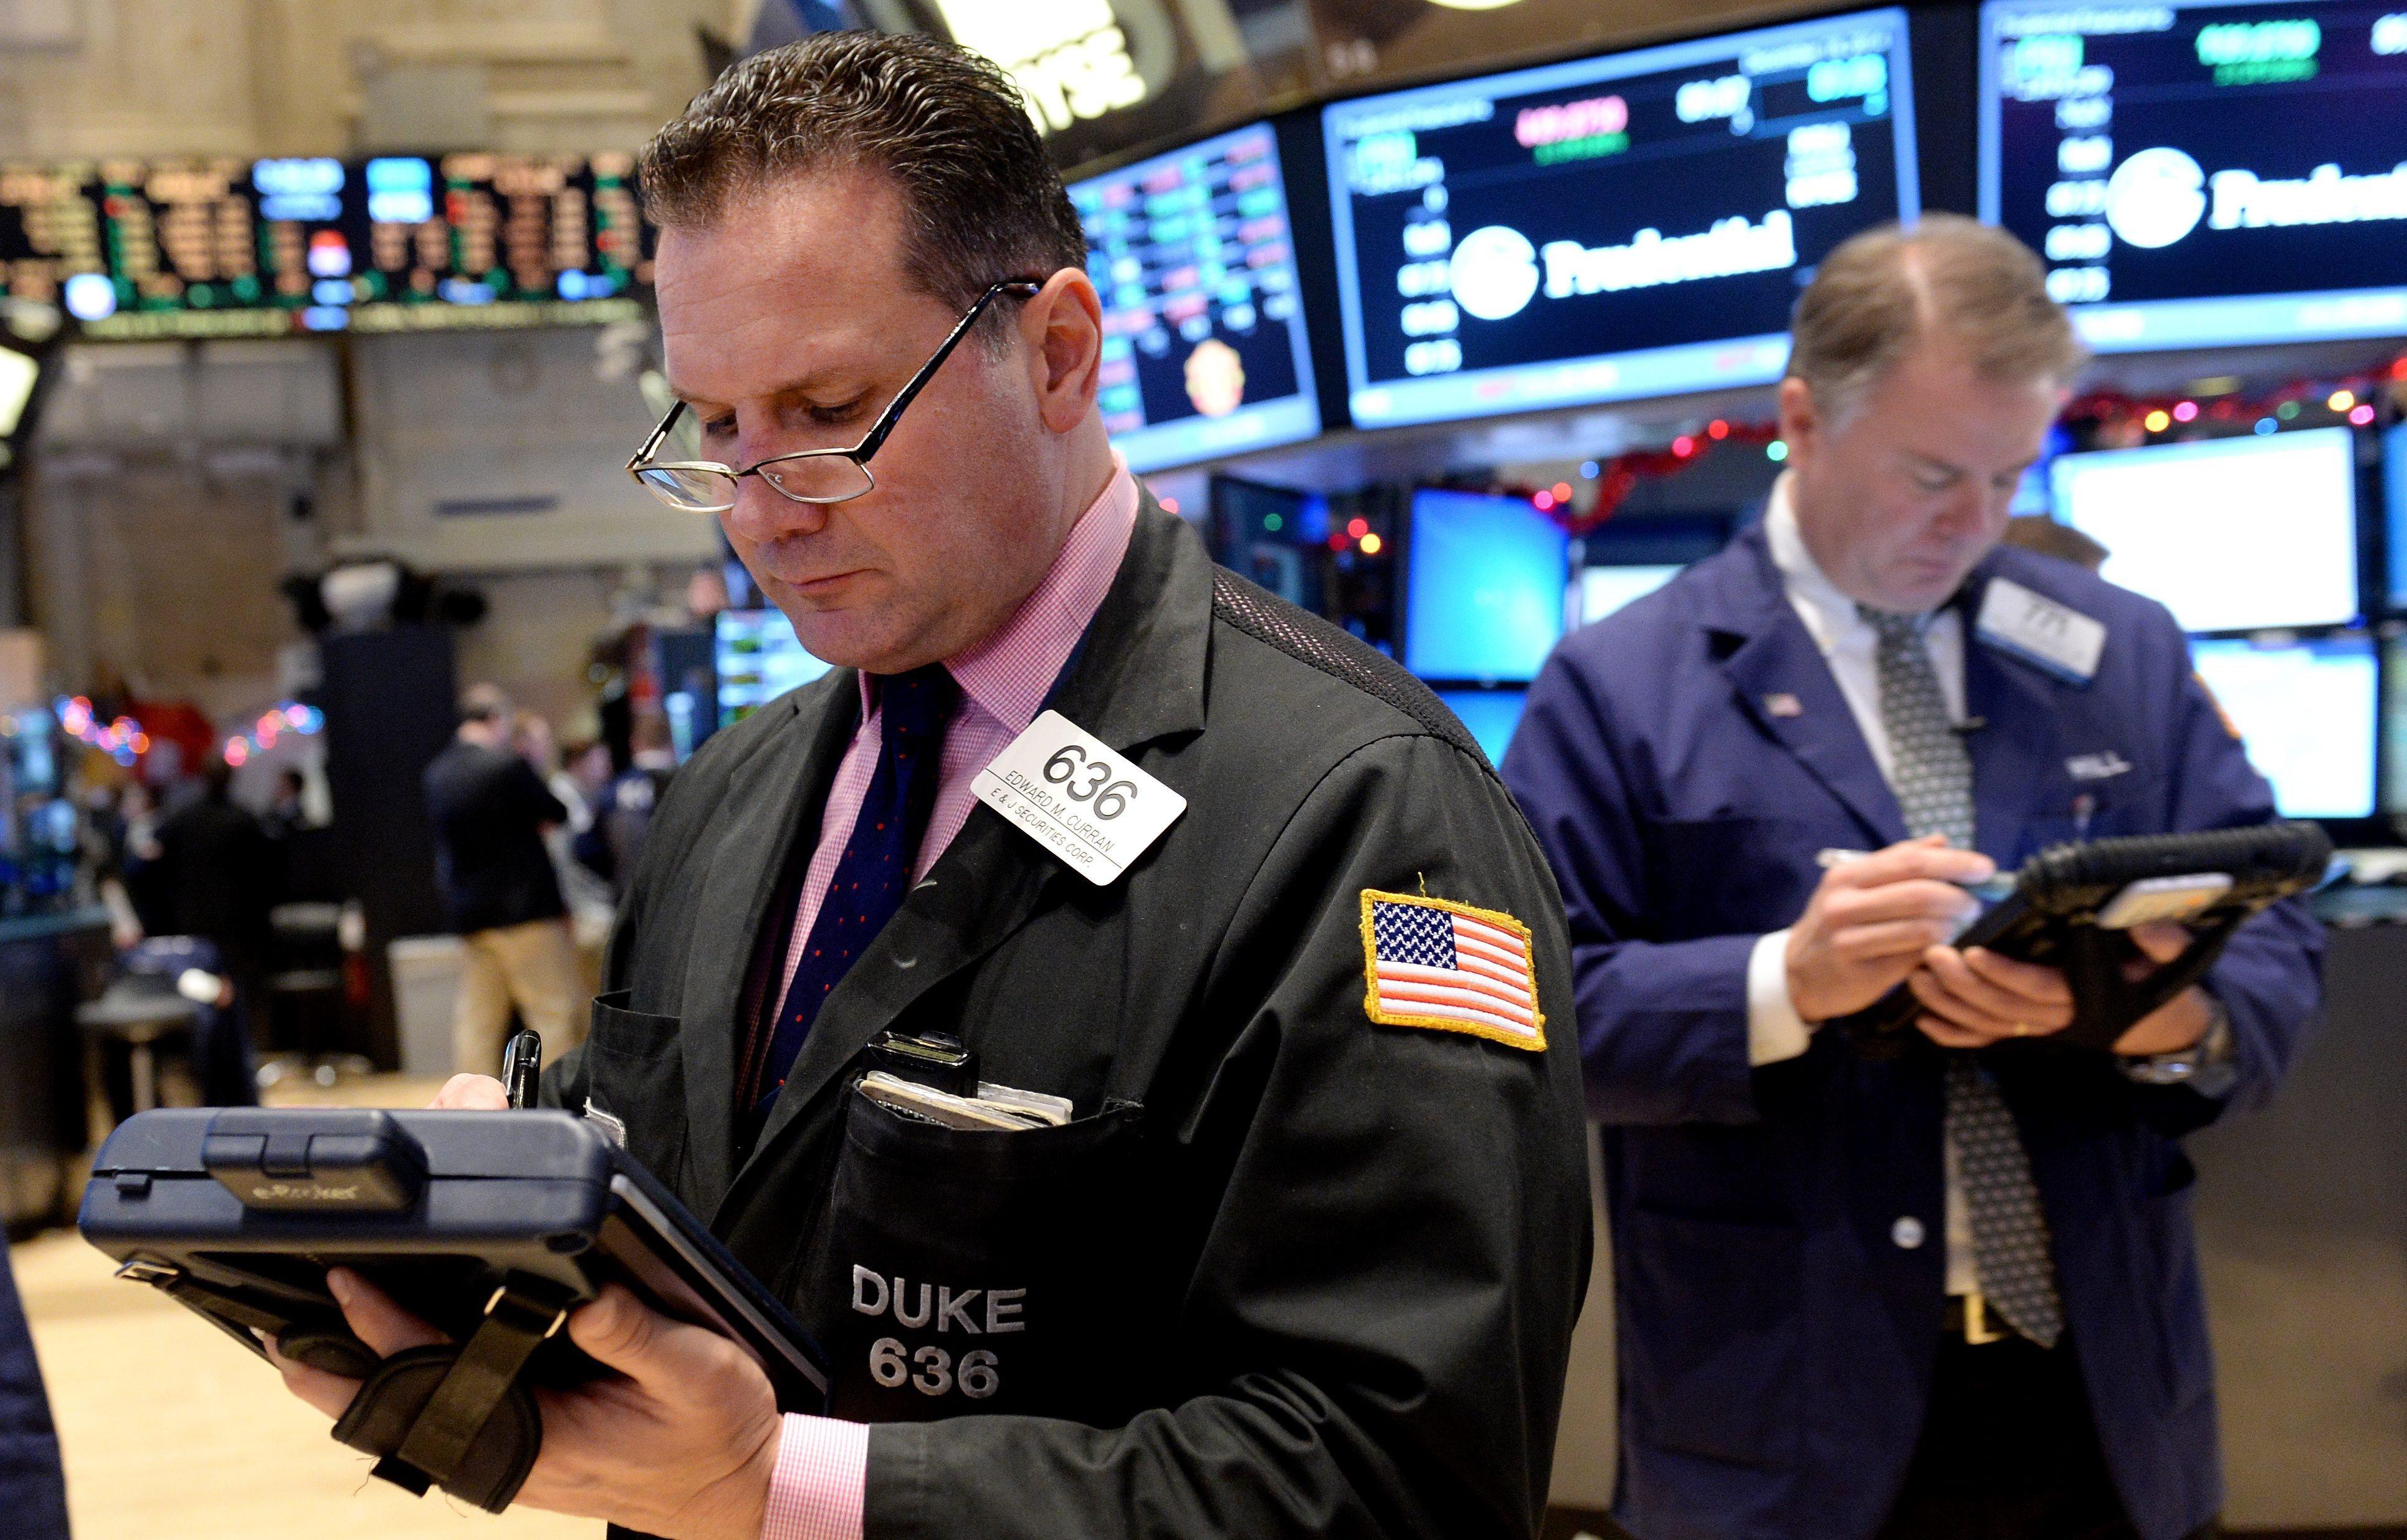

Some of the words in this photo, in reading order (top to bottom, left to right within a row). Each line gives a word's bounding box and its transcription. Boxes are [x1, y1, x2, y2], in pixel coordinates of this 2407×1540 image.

[1004, 770, 1053, 807] EDWARD
[1050, 803, 1066, 819] M.
[1066, 815, 1115, 853] CURRAN
[1043, 744, 1138, 820] 636
[991, 787, 1001, 797] E
[998, 794, 1009, 805] &
[1007, 801, 1017, 809] J
[1014, 806, 1067, 846] SECURITIES
[1065, 843, 1094, 868] CORP.
[852, 1263, 1027, 1334] DUKE
[869, 1337, 999, 1399] 636
